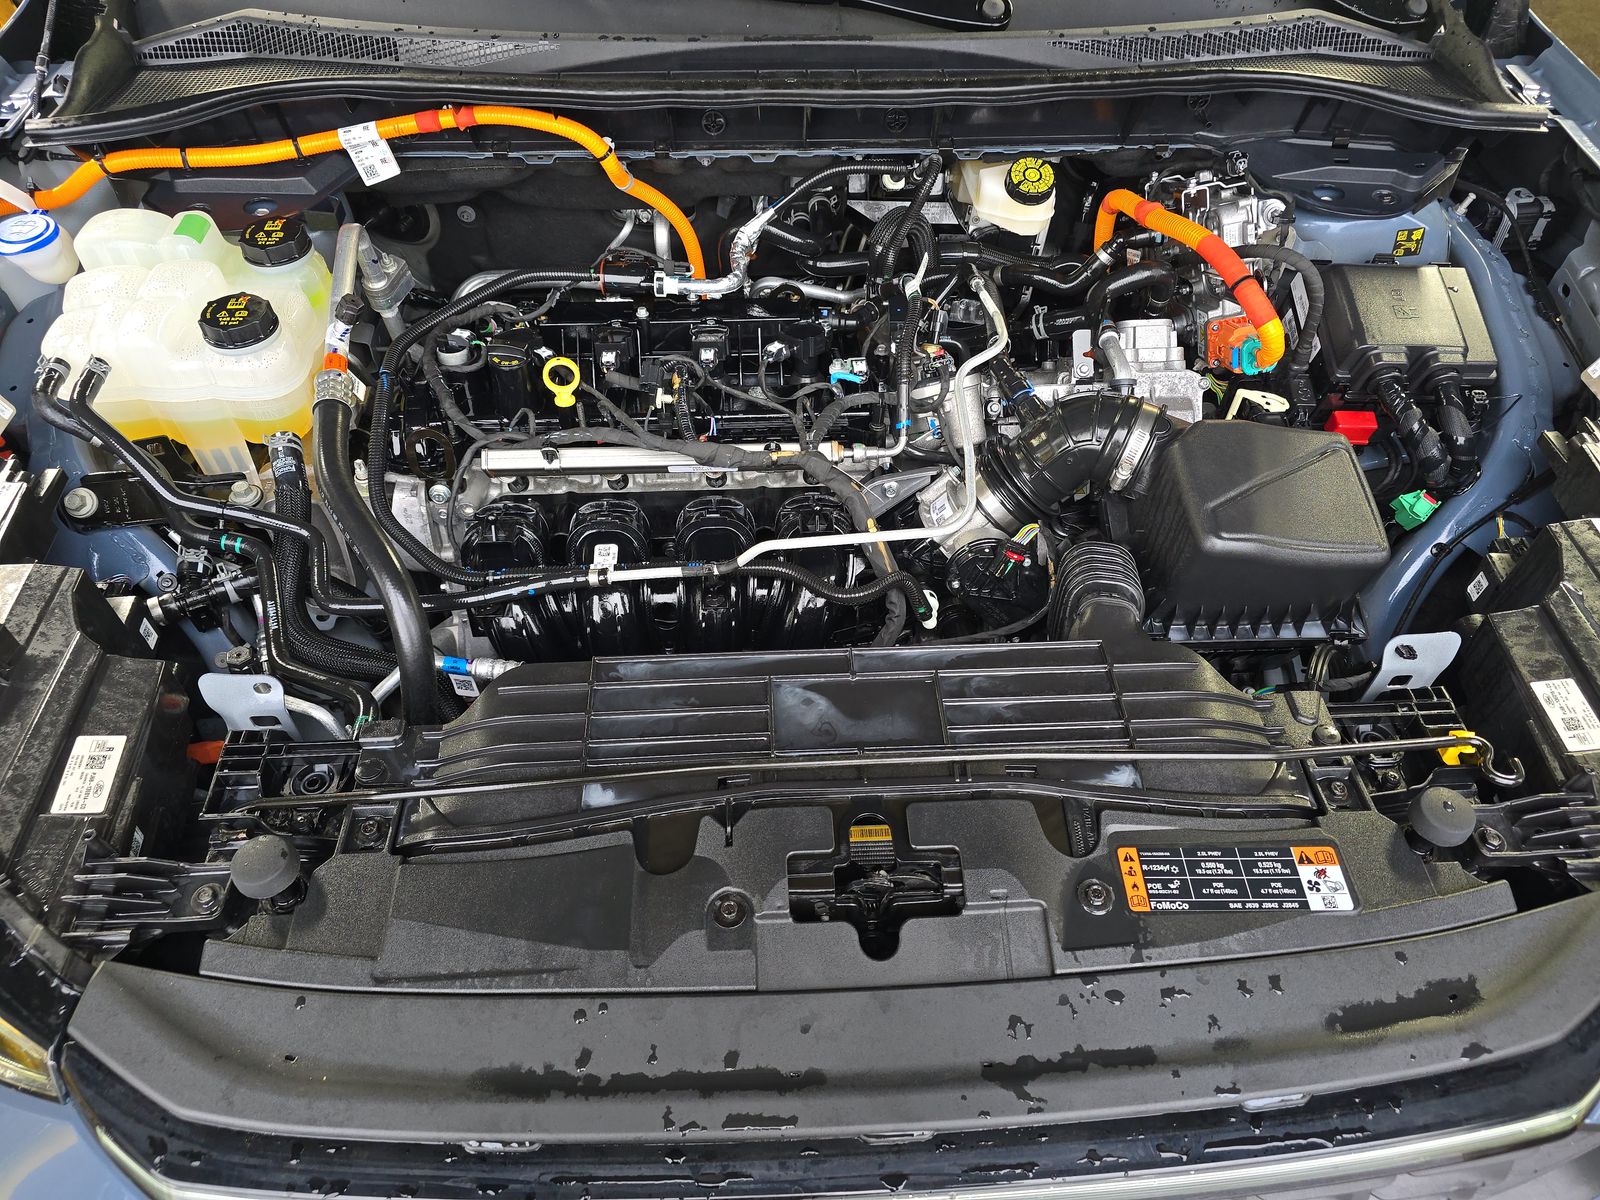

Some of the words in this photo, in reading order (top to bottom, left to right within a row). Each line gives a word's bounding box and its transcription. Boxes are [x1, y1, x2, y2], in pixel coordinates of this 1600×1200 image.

[1215, 862, 1225, 870] kg
[1273, 862, 1282, 870] kg
[1151, 902, 1189, 910] FoMoCo
